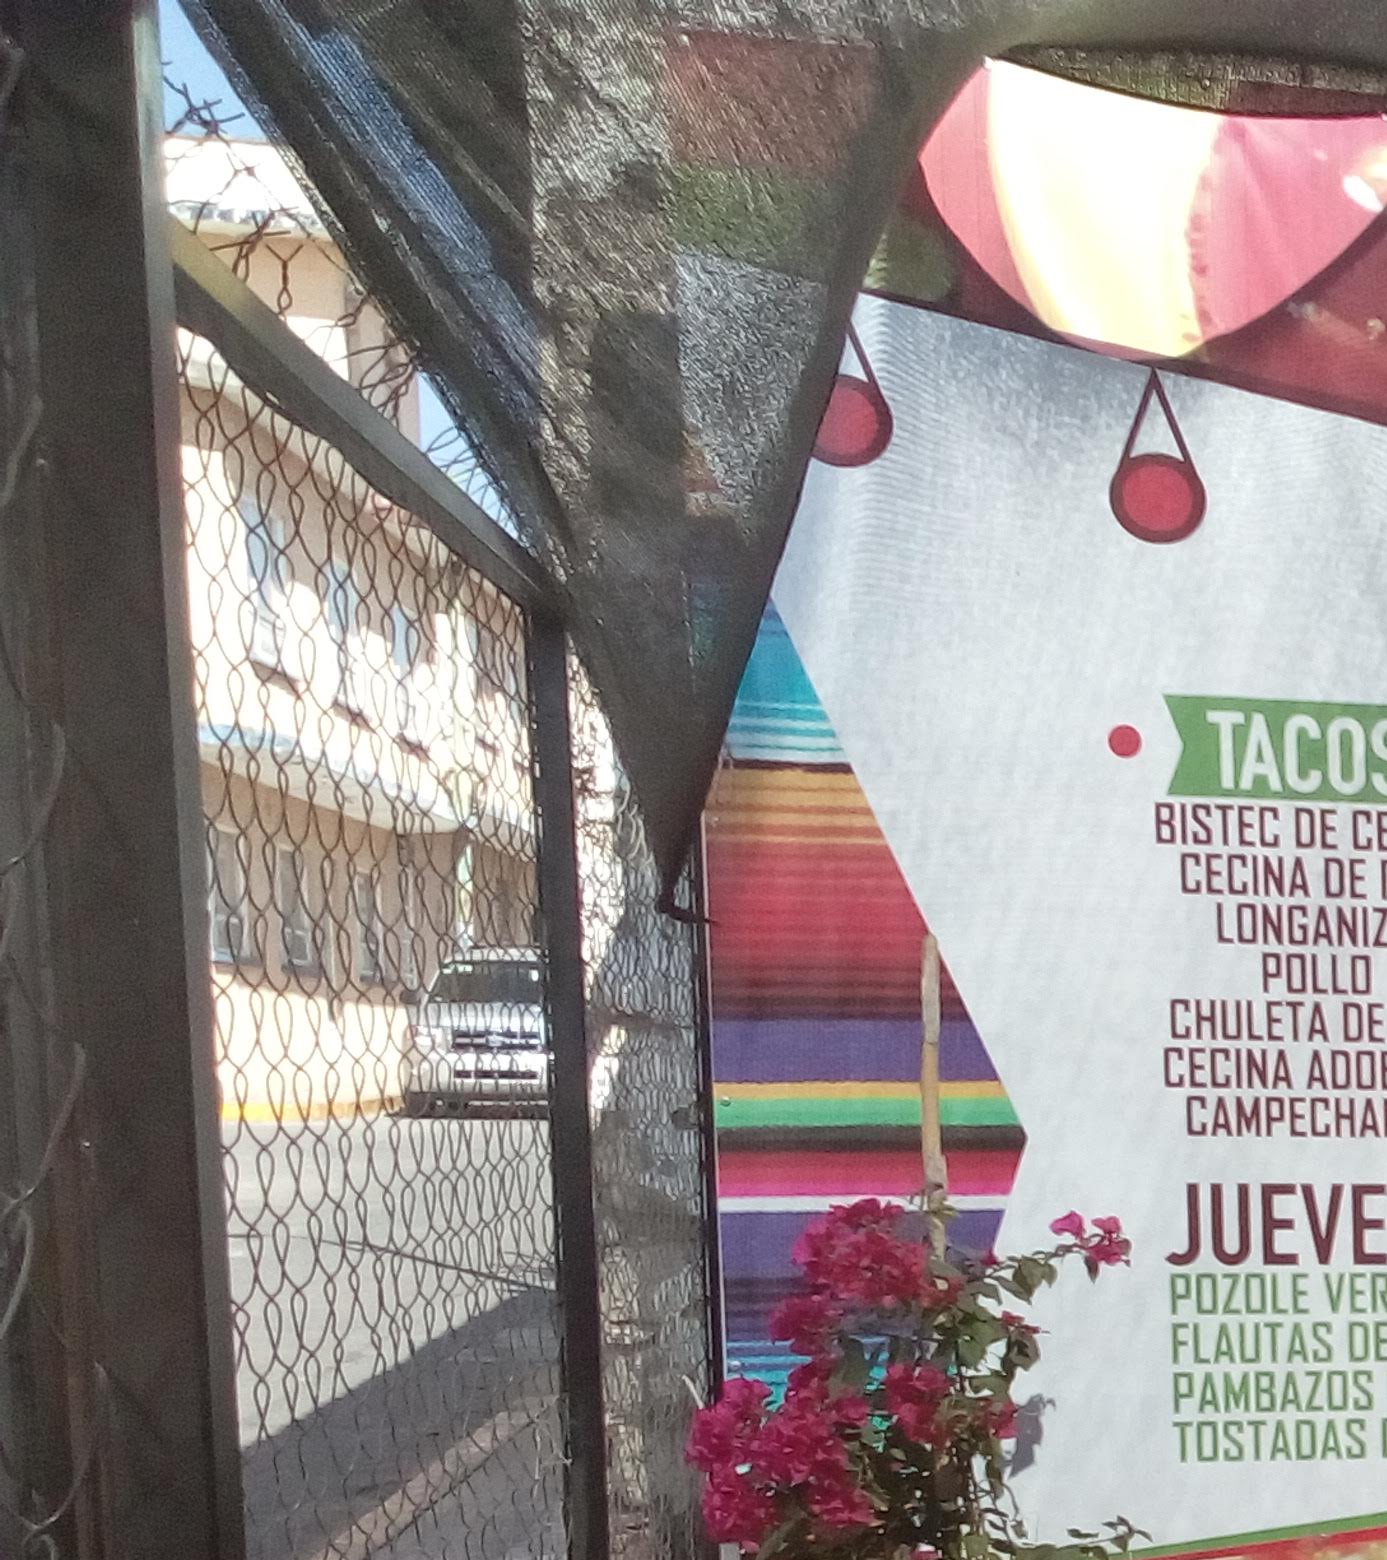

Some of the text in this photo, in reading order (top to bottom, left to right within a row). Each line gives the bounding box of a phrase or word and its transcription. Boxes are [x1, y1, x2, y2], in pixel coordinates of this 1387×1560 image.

[1154, 802, 1281, 849] BISTEC
[1294, 806, 1338, 849] DE
[1180, 853, 1311, 898] CECINA
[1323, 857, 1367, 900] DE
[1261, 952, 1373, 995] POLLO
[1169, 999, 1330, 1042] CHULETA
[1342, 1002, 1386, 1043] DE
[1162, 1047, 1294, 1089] CECINA
[1168, 1271, 1310, 1316] POZOLE
[1171, 1319, 1334, 1365] FLAUTAS
[1173, 1369, 1376, 1414] PAMBAZOS
[1172, 1418, 1367, 1463] TOSTADAS
